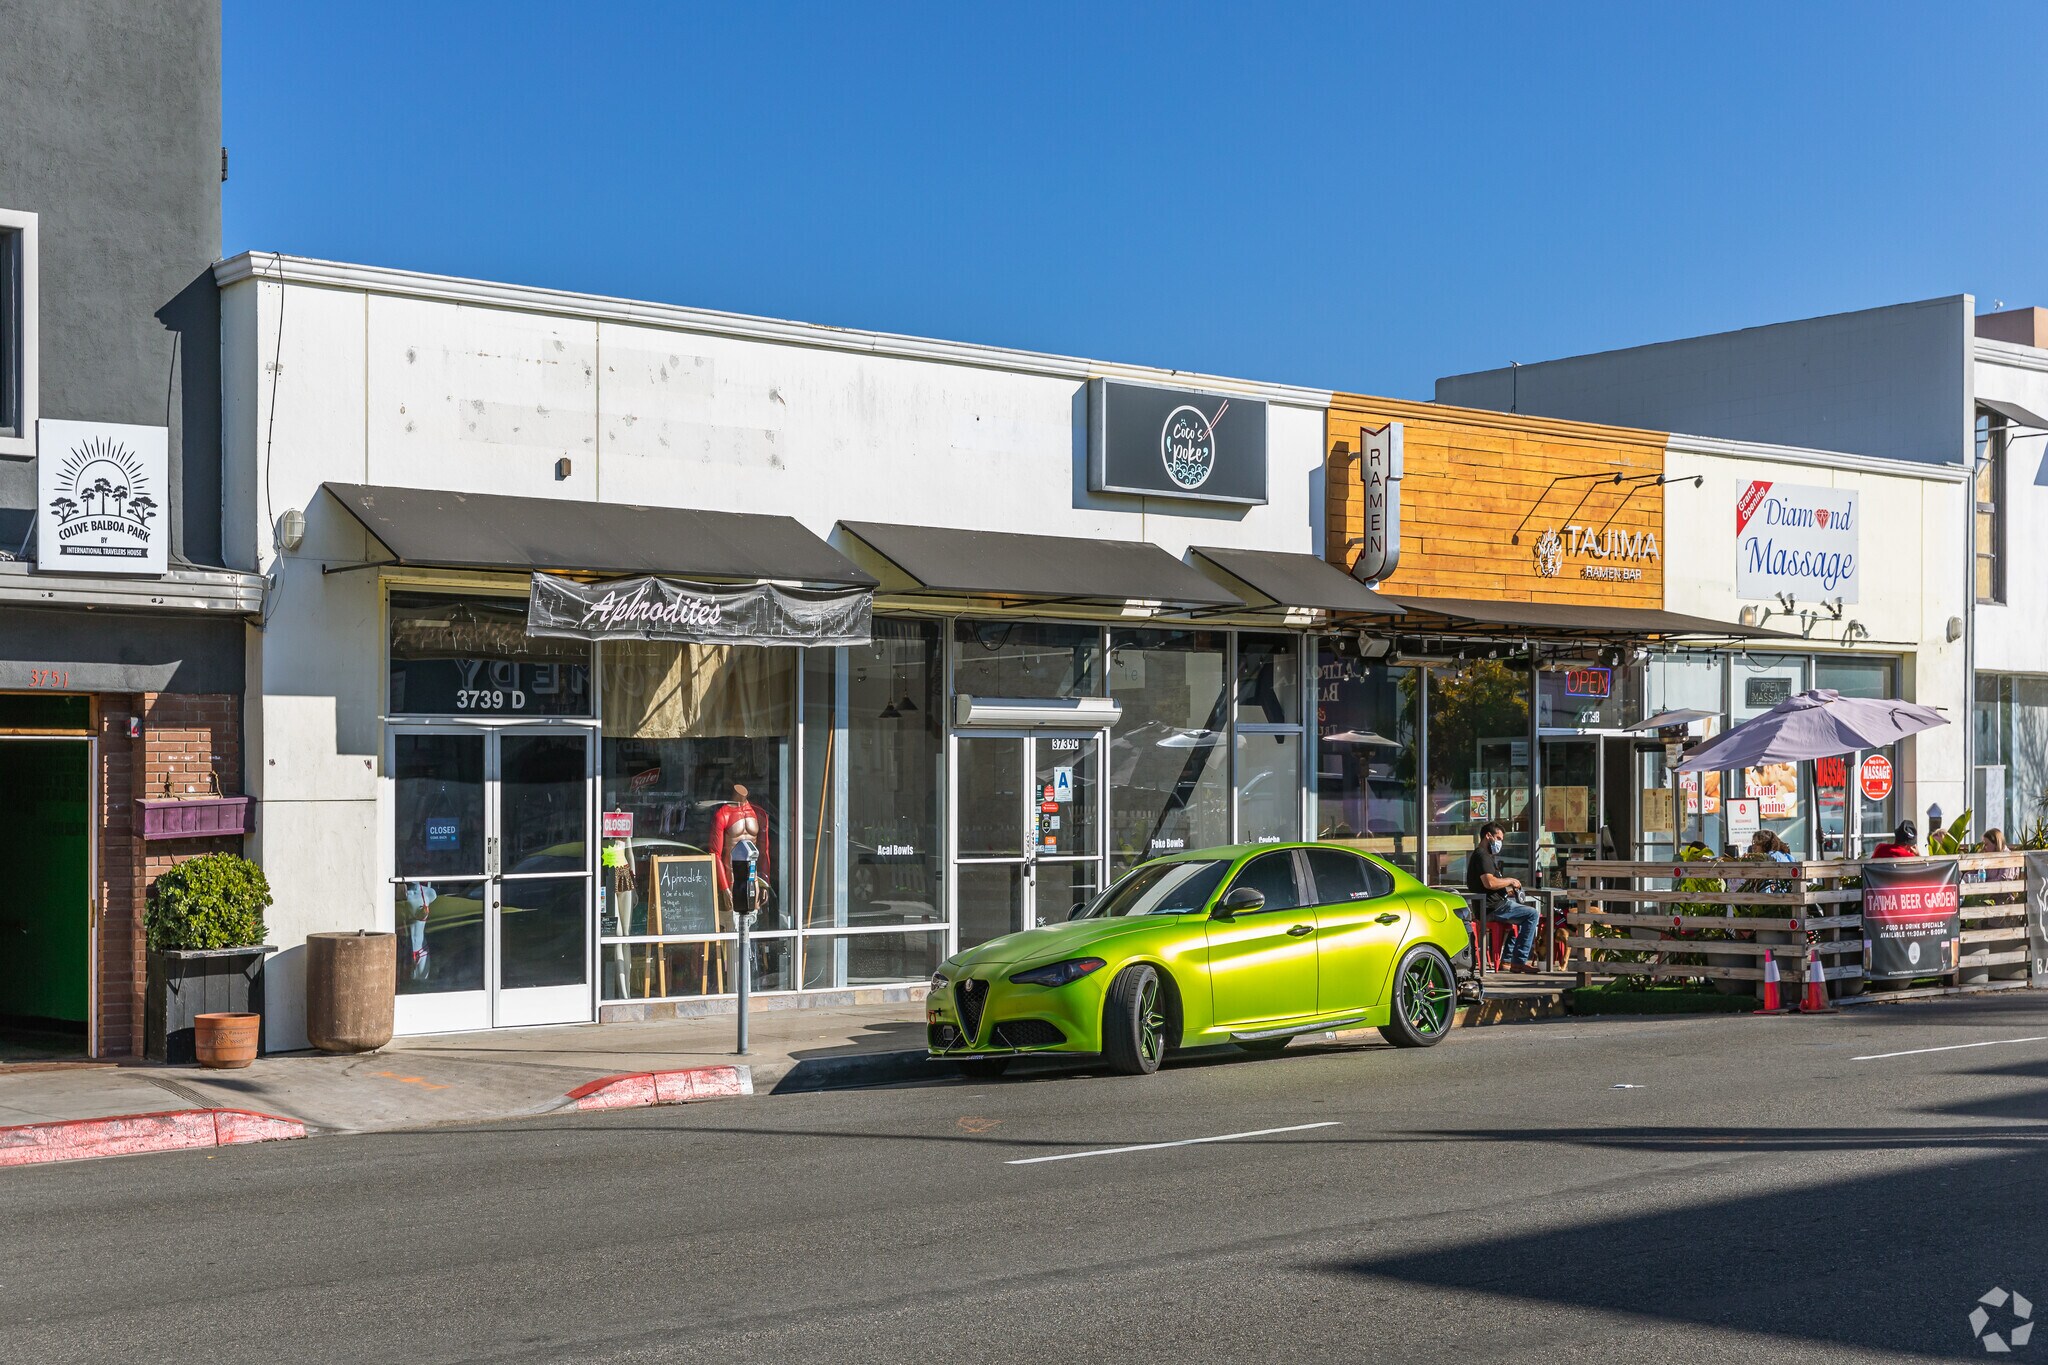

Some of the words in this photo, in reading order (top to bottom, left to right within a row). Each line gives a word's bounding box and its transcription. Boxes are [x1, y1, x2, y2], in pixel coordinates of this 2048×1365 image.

[1173, 422, 1203, 442] Coco's
[1173, 439, 1203, 470] poke
[1369, 448, 1383, 553] RAMEN
[1738, 484, 1756, 511] Grand
[1742, 486, 1766, 521] Opening
[58, 520, 89, 541] COLIVE
[91, 519, 125, 532] BALBOA
[126, 521, 151, 543] PARK
[100, 536, 108, 544] BY
[66, 546, 102, 555] INTERNATIONAL
[102, 547, 126, 556] TRAVELERS
[126, 548, 142, 556] HOUSE
[1565, 525, 1660, 560] TAJIMA
[1586, 565, 1621, 579] RAMEN
[1623, 568, 1642, 580] BAR
[1744, 536, 1856, 591] Massage
[582, 589, 722, 630] Aphrodite's
[29, 669, 69, 688] 3751
[1567, 669, 1609, 694] OPEN
[1760, 682, 1780, 692] OPEN
[457, 690, 504, 709] 3739
[512, 691, 525, 709] D
[1053, 739, 1079, 750] 3739C
[1058, 772, 1069, 789] A
[1817, 757, 1846, 787] MASSAG
[1863, 765, 1891, 780] MASSAGE
[1760, 802, 1786, 813] ening
[429, 826, 456, 835] CLOSED
[604, 818, 632, 832] CLOSED
[893, 844, 914, 856] Bowls
[1151, 838, 1166, 849] Poke
[1166, 837, 1184, 848] Bowls
[1900, 892, 1921, 910] BEER
[1924, 890, 1957, 909] GARDEN
[1880, 931, 1905, 939] AVAILABLE
[1885, 923, 1898, 932] FOOD
[1905, 922, 1920, 931] DRINK
